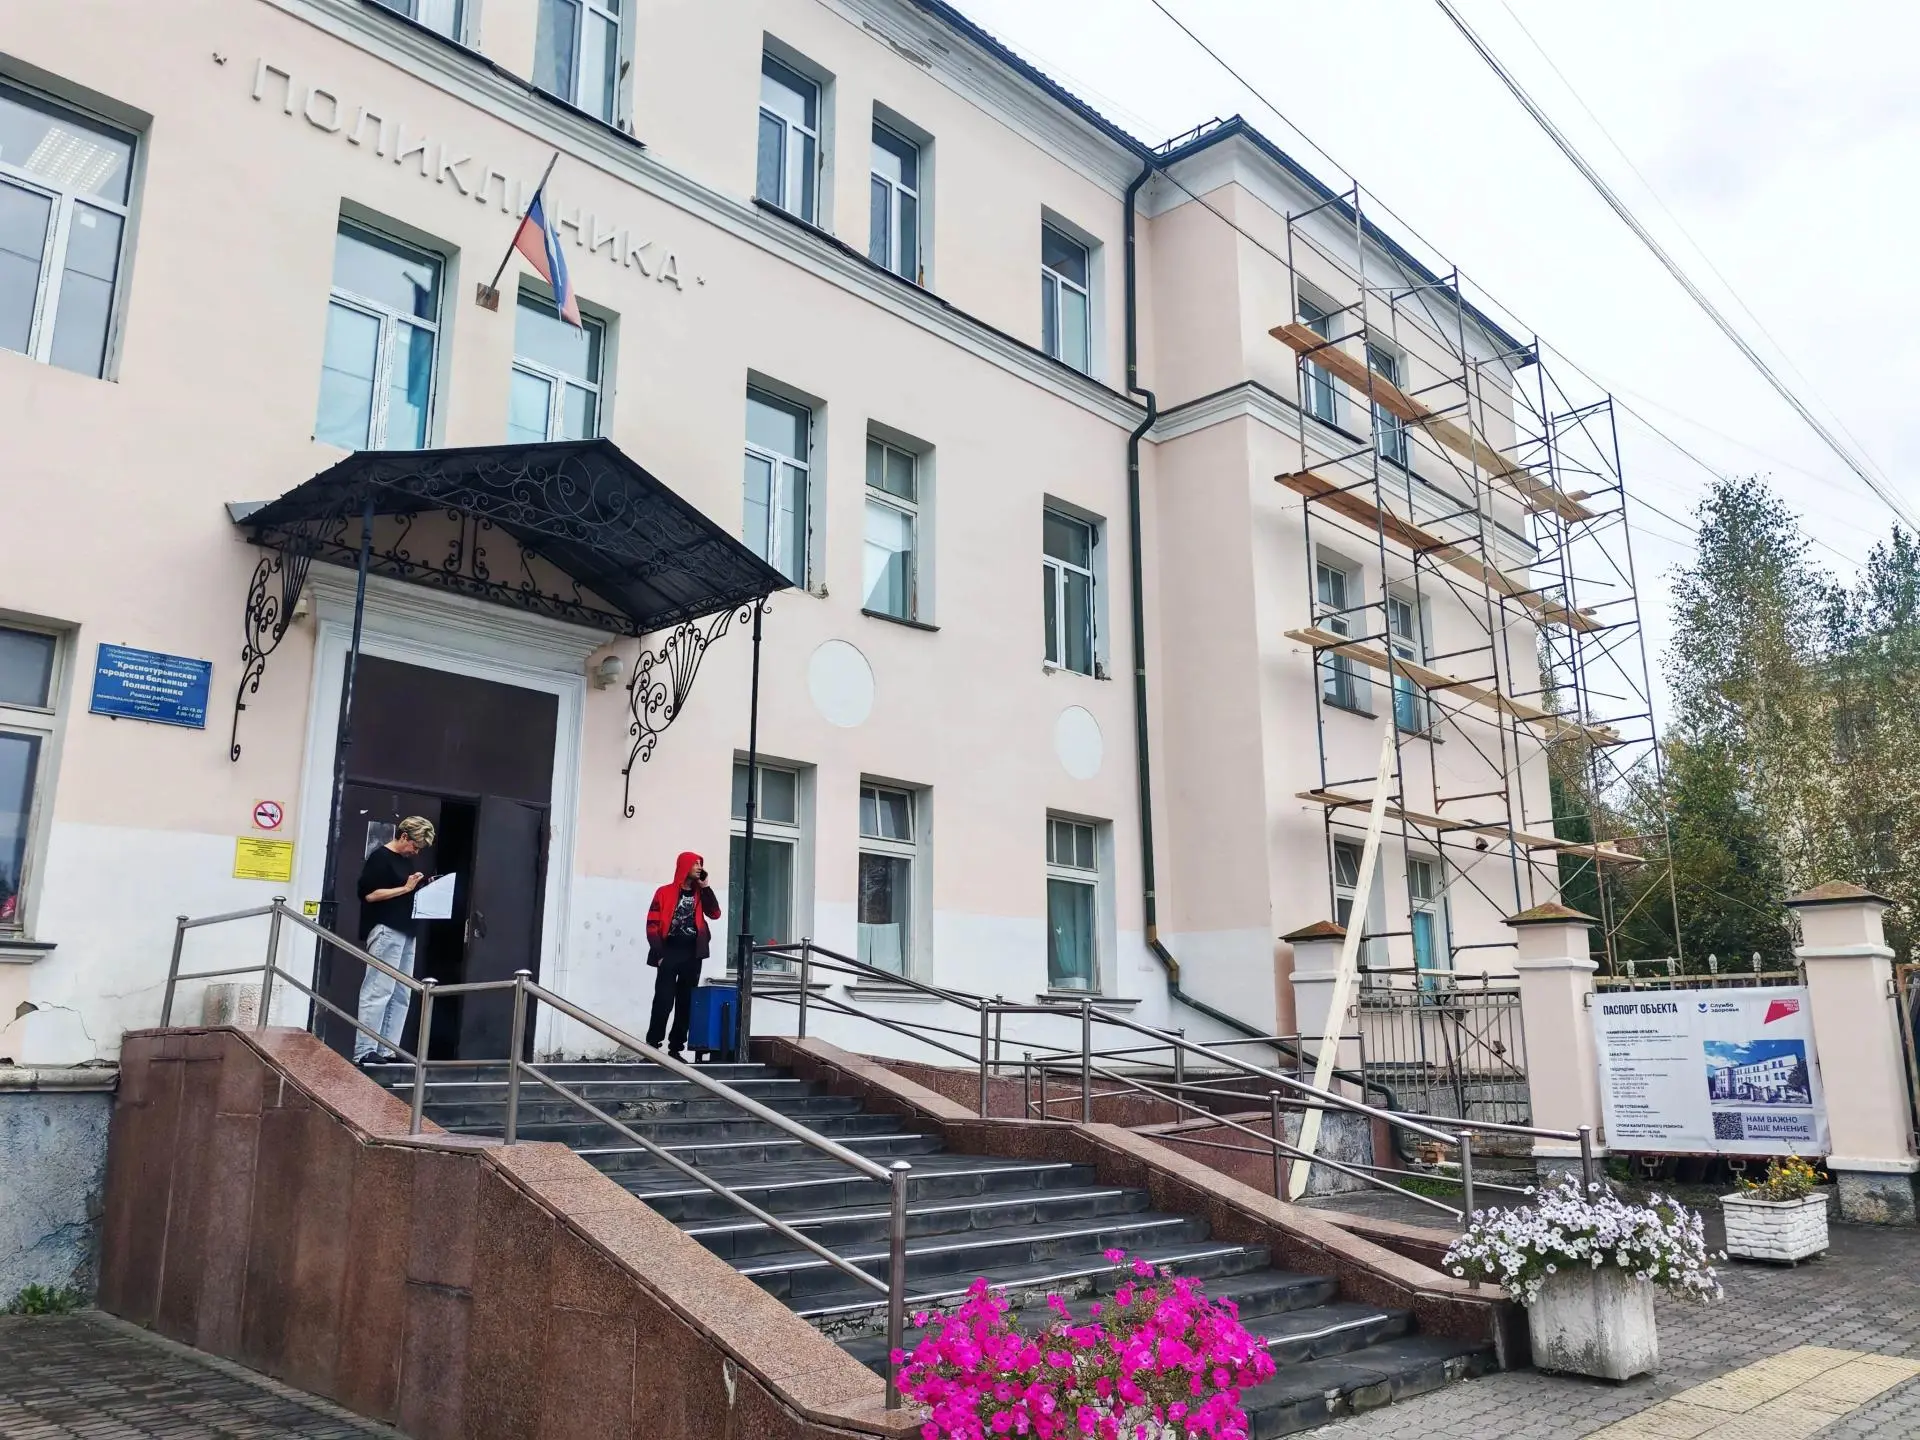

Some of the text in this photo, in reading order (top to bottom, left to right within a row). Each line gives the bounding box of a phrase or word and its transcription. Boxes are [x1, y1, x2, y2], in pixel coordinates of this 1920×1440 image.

[98, 667, 145, 681] городская
[122, 680, 184, 696] Поликлиника
[1603, 1003, 1678, 1016] ПАСПОРТ ОБЪЕКТА
[1745, 1115, 1798, 1124] НАМ ВАЖНО
[1747, 1124, 1809, 1133] ВАШЕ МНЕНИЕ
